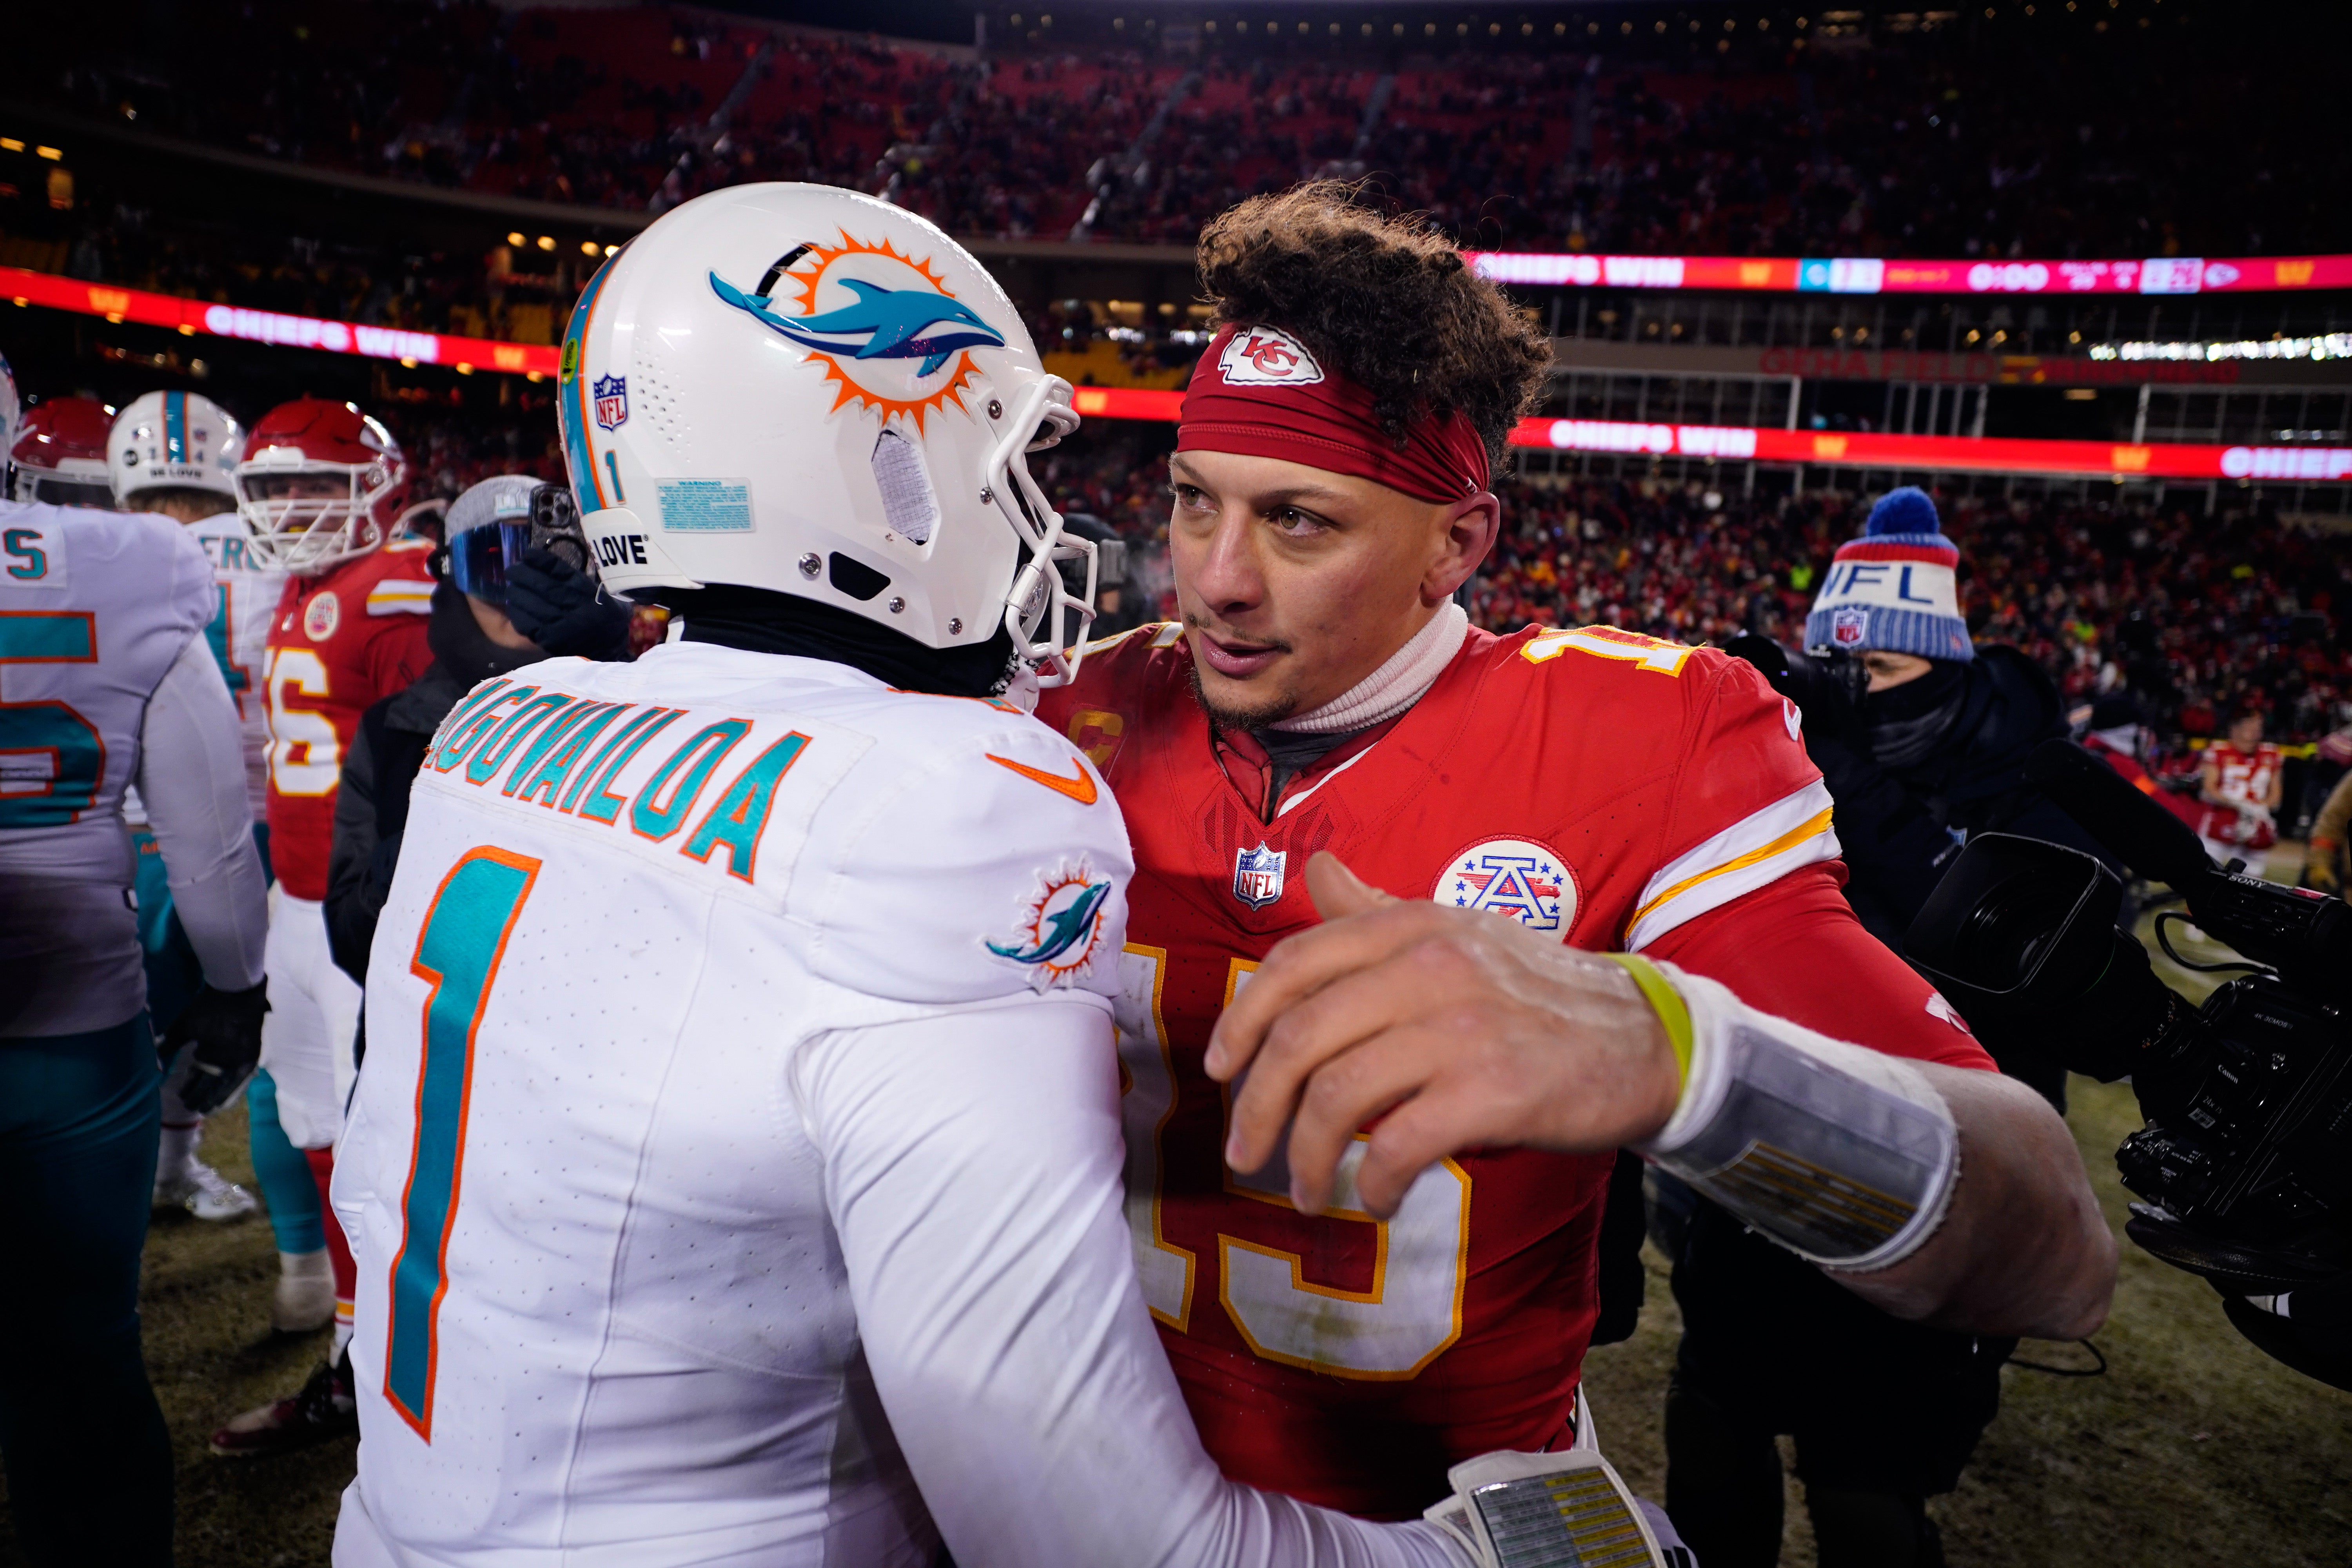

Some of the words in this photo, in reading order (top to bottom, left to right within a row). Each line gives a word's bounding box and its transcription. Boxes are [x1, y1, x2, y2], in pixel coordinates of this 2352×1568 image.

[1474, 253, 1600, 286] CHIEFS
[1604, 256, 1684, 288] WIN
[205, 305, 350, 352] CHIEFS
[354, 325, 439, 364] WIN
[1241, 336, 1300, 377] KC
[1759, 347, 1871, 379] GEHA
[1882, 350, 1995, 383] FIELD
[597, 397, 624, 425] NFL
[1549, 419, 1673, 452] CHIEFS
[1677, 426, 1757, 457] WIN
[606, 450, 625, 502] 1
[2219, 446, 2352, 479] CHIEF
[262, 646, 339, 796] 6
[1239, 871, 1275, 900] NFL
[2229, 875, 2267, 888] SONY
[2218, 1064, 2239, 1085] Canon
[385, 846, 542, 1445] 1
